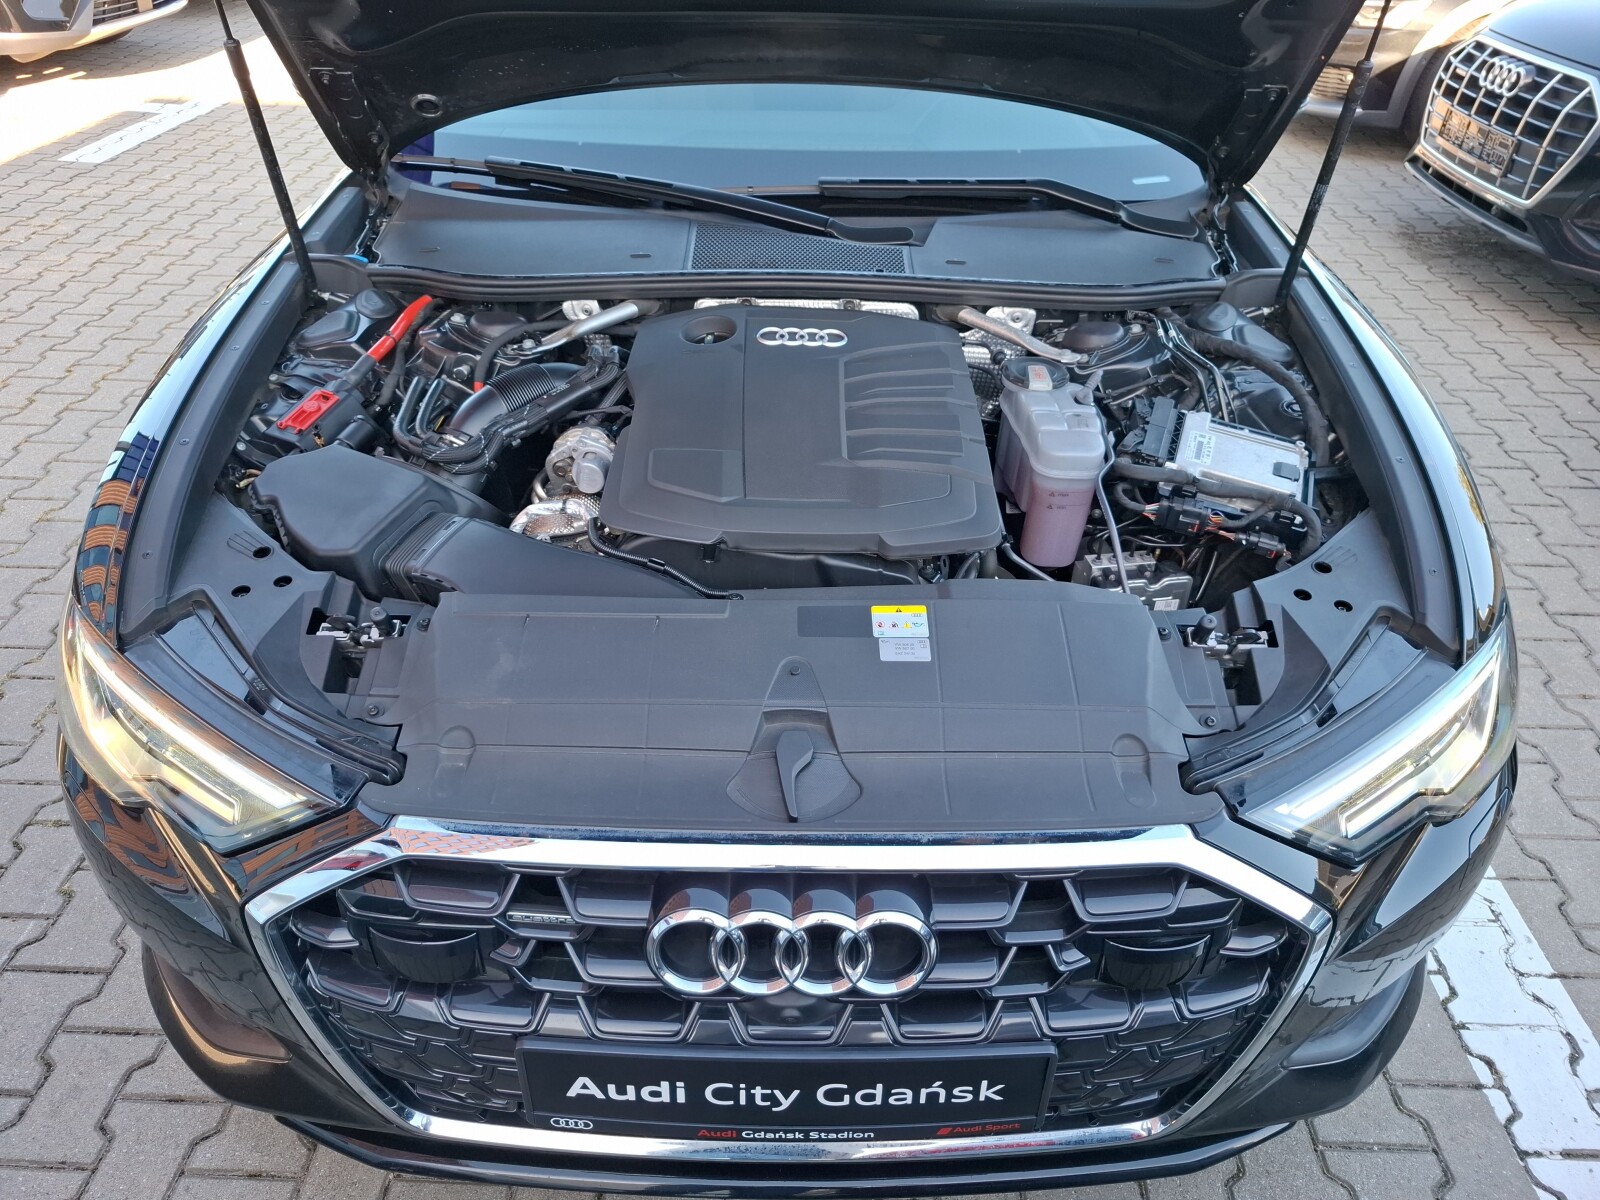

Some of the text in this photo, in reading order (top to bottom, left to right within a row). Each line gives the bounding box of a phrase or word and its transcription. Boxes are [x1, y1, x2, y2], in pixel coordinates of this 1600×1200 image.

[512, 914, 576, 924] quattro
[566, 1076, 1006, 1111] Audi City Gdańsk
[953, 1123, 1021, 1133] Audi Sport
[697, 1129, 875, 1139] Audi Gdańsk Stadion
